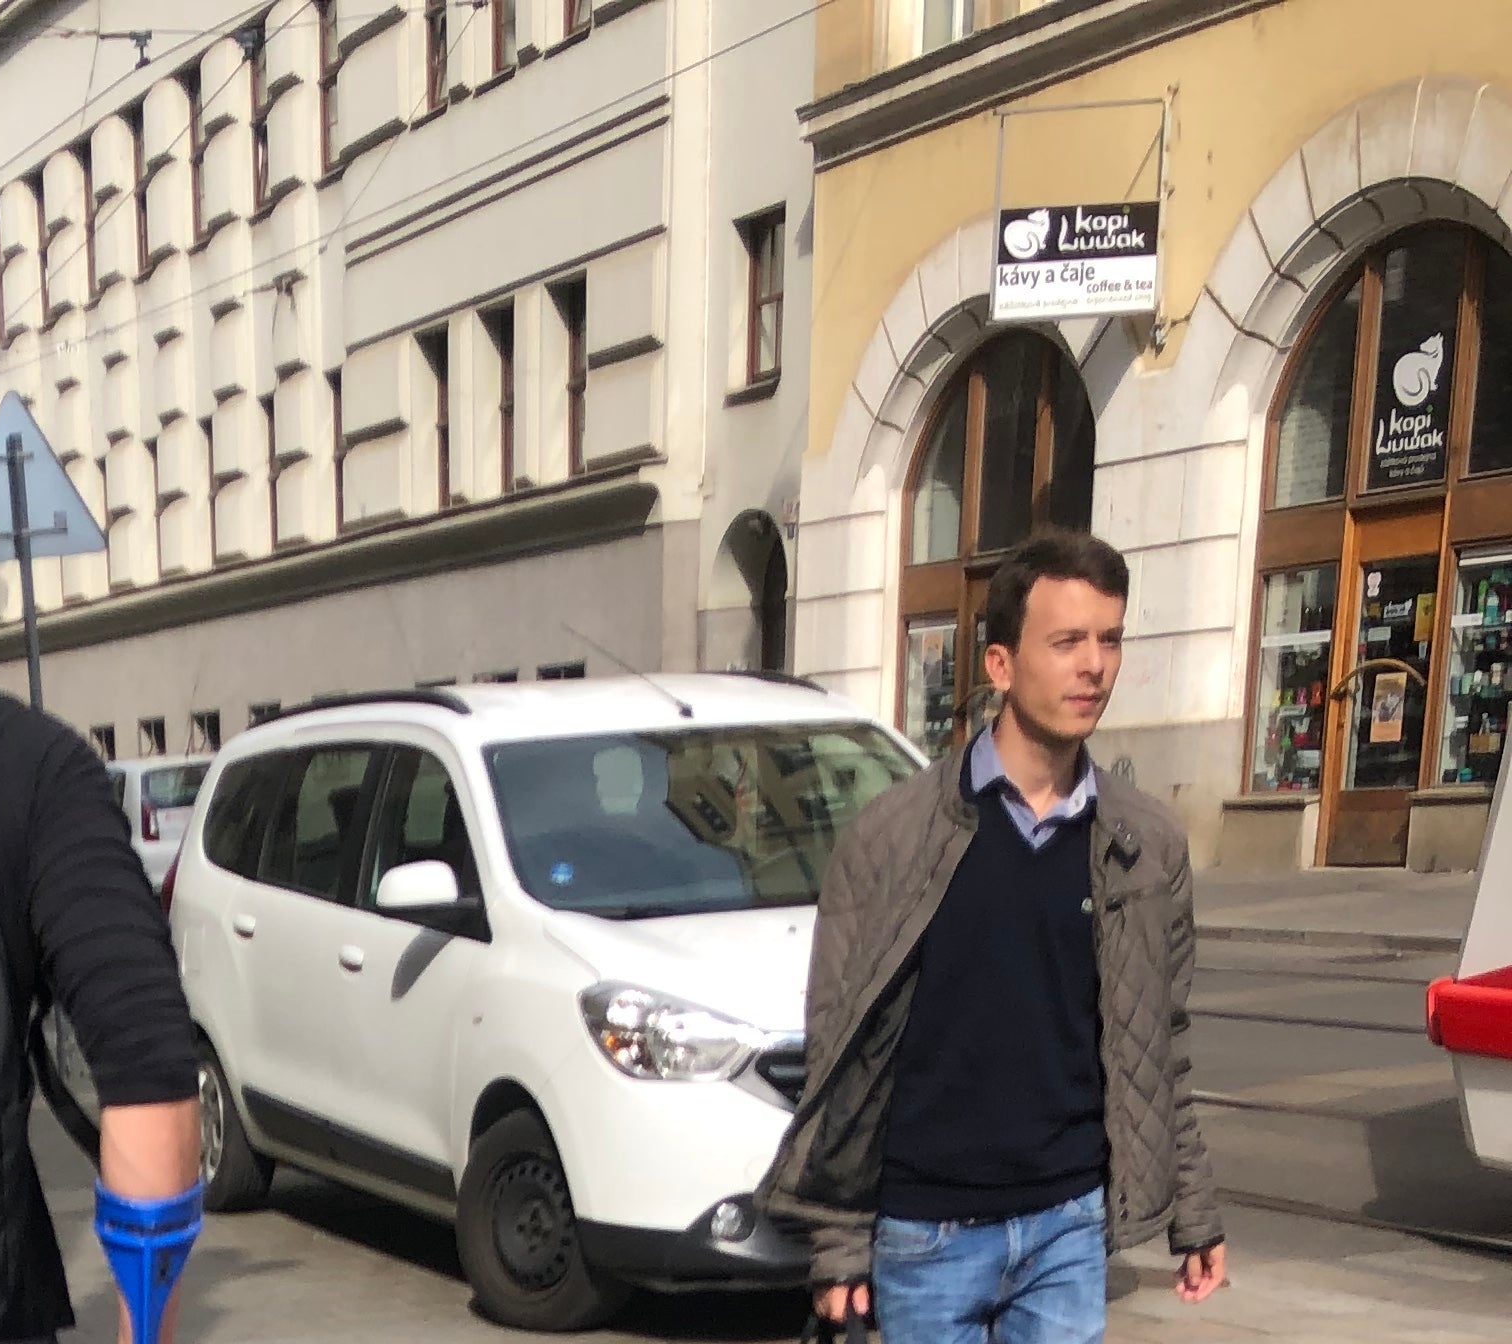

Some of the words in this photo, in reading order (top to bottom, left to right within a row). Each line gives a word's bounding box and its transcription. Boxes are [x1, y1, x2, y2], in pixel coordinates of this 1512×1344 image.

[1075, 204, 1130, 238] kopi
[999, 265, 1040, 289] kávy
[1045, 268, 1055, 283] a
[1060, 262, 1095, 286] čaje
[1087, 279, 1121, 293] coffee
[1124, 279, 1133, 291] &
[1135, 279, 1153, 290] tea
[1389, 404, 1434, 437] kopi
